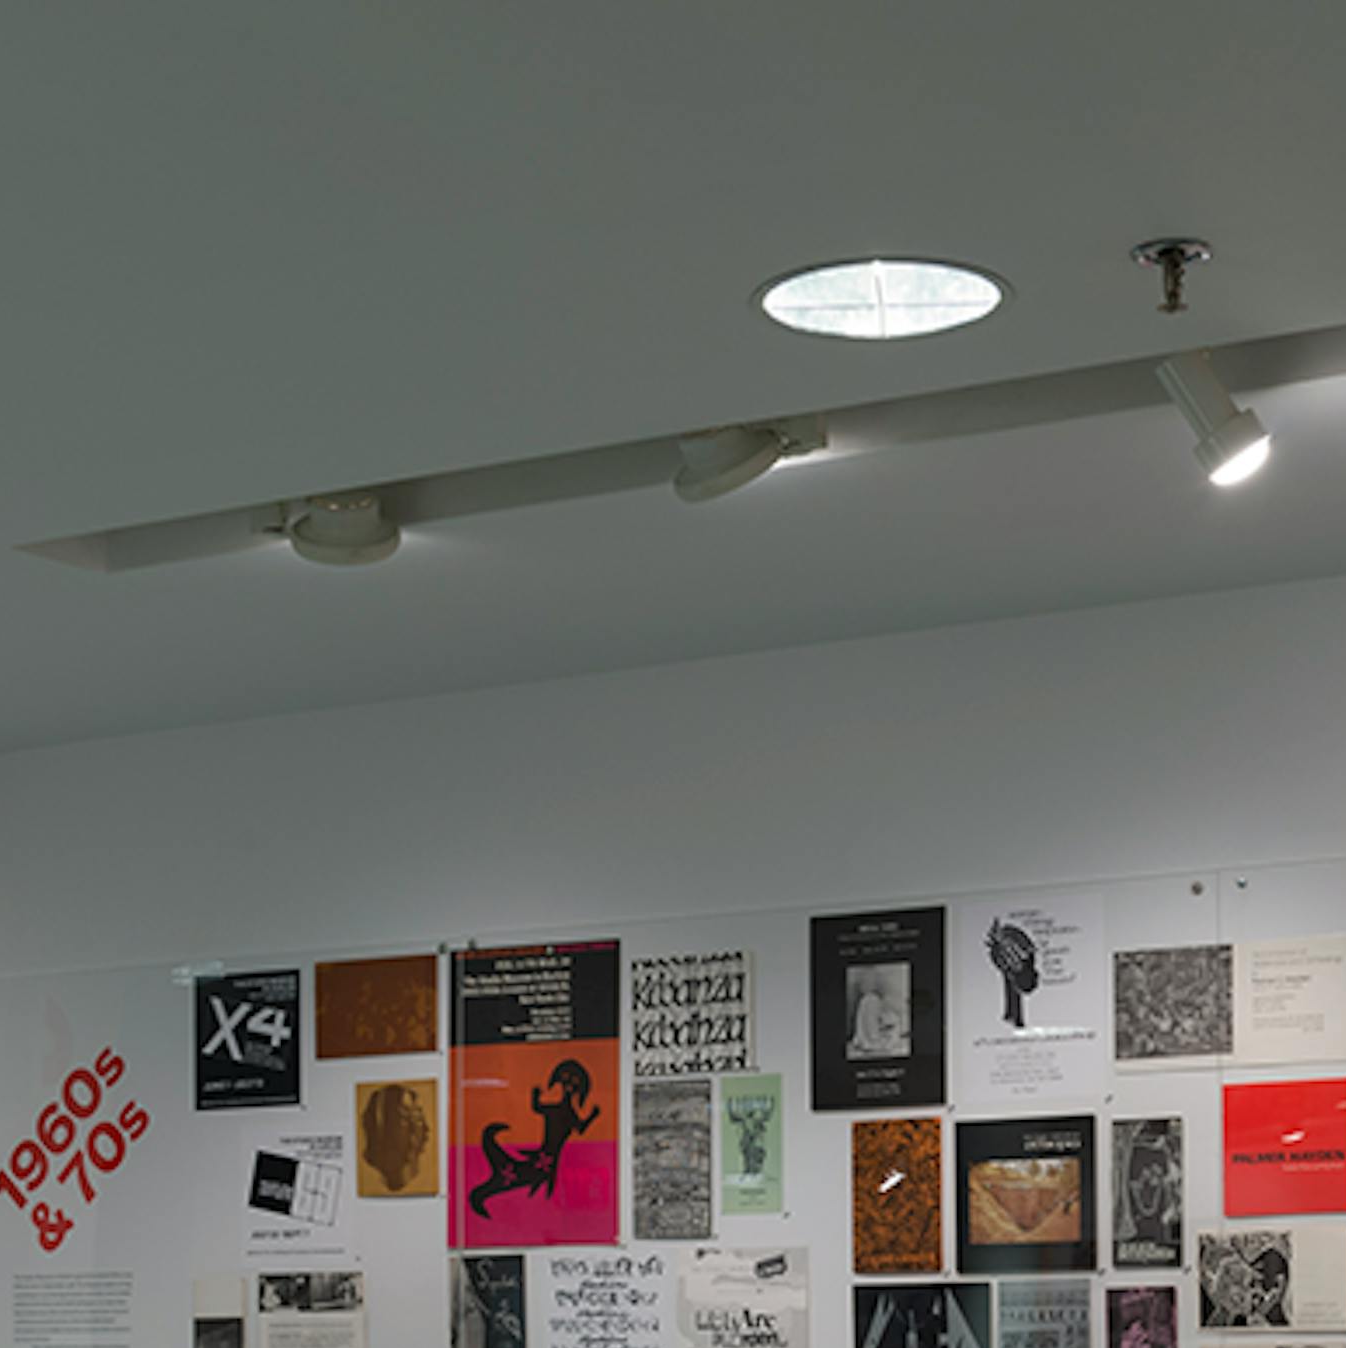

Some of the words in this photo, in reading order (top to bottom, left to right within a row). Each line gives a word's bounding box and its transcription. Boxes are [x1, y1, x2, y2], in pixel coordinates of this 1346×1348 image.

[202, 995, 291, 1061] X4
[31, 1202, 73, 1252] &
[57, 1100, 149, 1204] 70s
